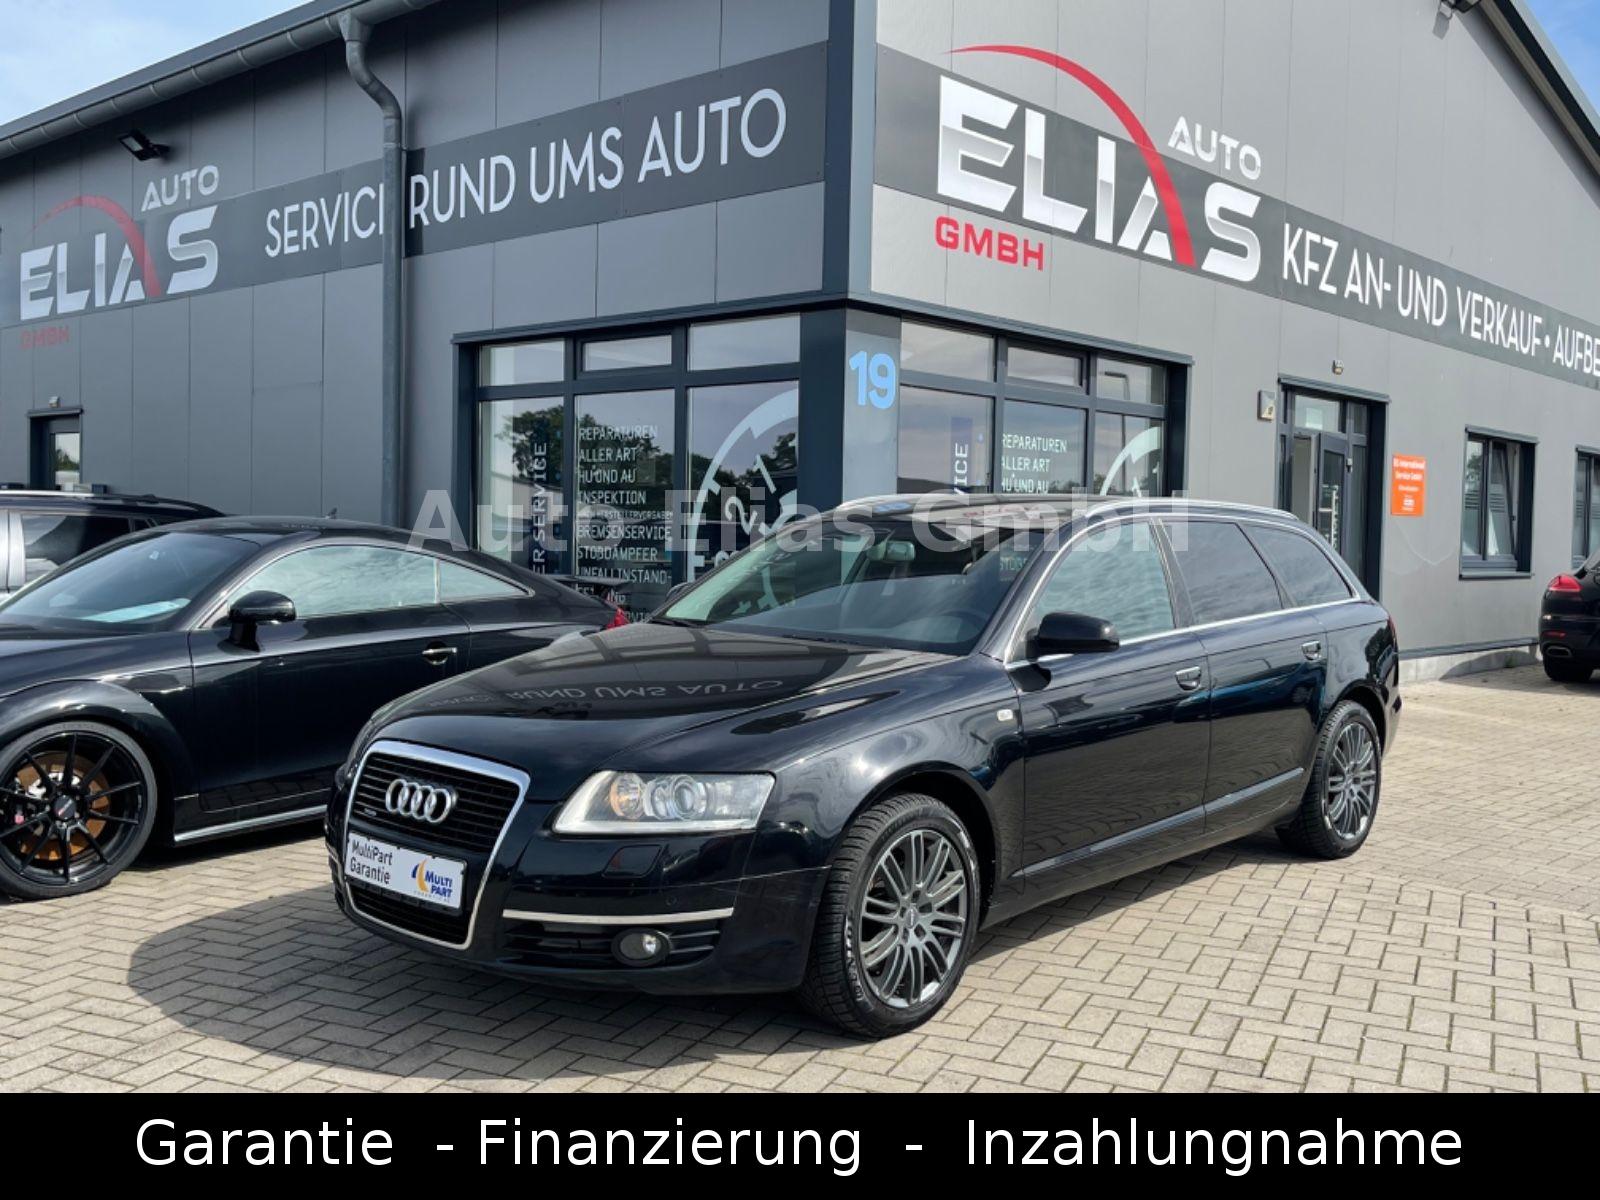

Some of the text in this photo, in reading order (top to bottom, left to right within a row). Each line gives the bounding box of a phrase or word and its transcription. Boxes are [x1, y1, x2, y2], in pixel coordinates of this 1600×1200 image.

[264, 88, 787, 258] SERVIC RUND UMS AUTO
[1168, 116, 1261, 180] AUTO
[141, 165, 219, 212] AUTO
[938, 75, 1261, 282] ELIAS
[20, 205, 218, 321] ELIAS
[935, 216, 1044, 271] GMBH
[1283, 223, 1339, 295] KFZ
[1397, 265, 1447, 326] UND
[849, 350, 896, 409] 19
[579, 425, 657, 440] REPARATUREN
[616, 447, 637, 461] ART
[533, 442, 547, 542] SERVICE
[579, 489, 647, 504] INSPEKTION
[620, 468, 636, 484] AU
[350, 857, 391, 885] Garantie
[351, 840, 393, 866] MultiPart
[431, 885, 453, 898] PART
